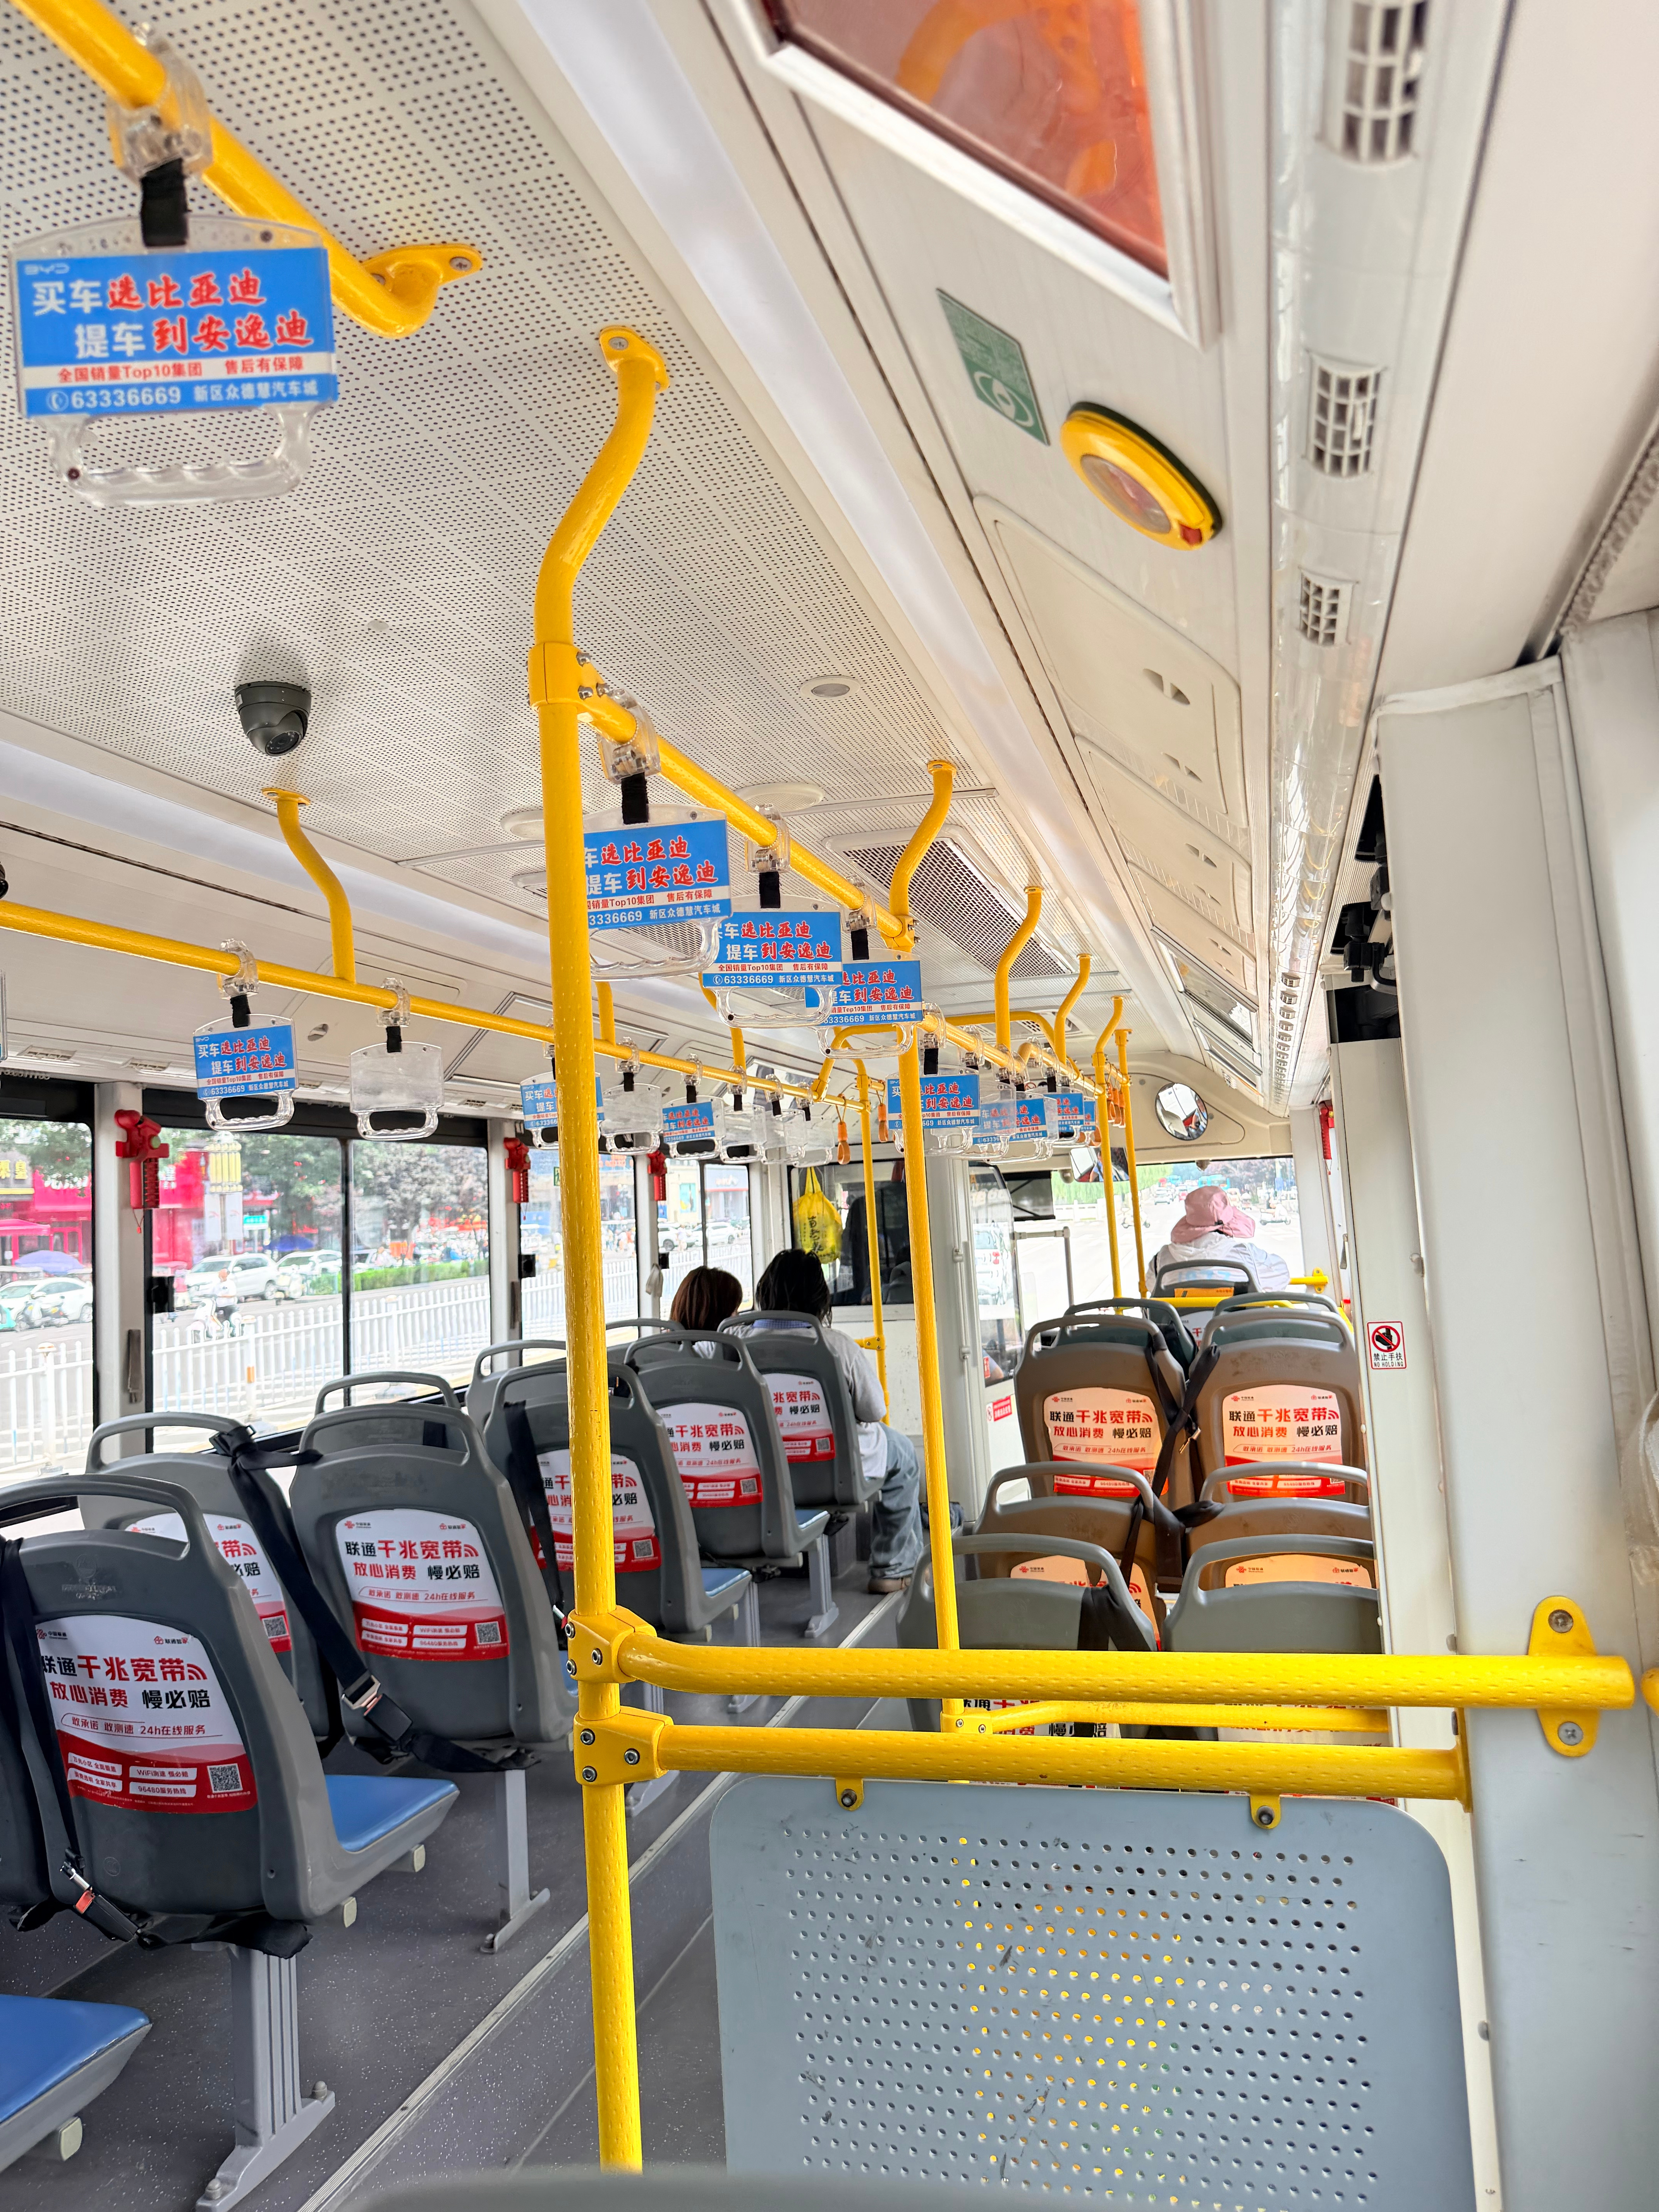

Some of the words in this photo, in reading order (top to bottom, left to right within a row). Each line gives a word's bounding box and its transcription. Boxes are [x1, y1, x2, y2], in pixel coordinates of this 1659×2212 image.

[24, 263, 70, 275] BYD
[33, 267, 267, 316] 买车选比亚迪
[75, 309, 314, 359] 提车到安逸迪
[58, 362, 203, 383] 全国销量Top10集团
[225, 356, 304, 375] 售后有保障
[71, 386, 181, 409] 63336669
[585, 835, 691, 868] 车选比亚迪
[667, 889, 713, 903] 售后有保障
[589, 910, 642, 926] 3336669
[649, 903, 721, 919] 新区众德慧汽车城
[726, 941, 832, 960] 提车到安逸迪
[724, 975, 773, 984] 63336669
[779, 975, 834, 983] 新区众德慧汽车城
[198, 1035, 271, 1058] 买车选比亚迪
[211, 1051, 287, 1075] 提车到安逸迪
[211, 1085, 245, 1095] 63336669
[1374, 1352, 1403, 1361] 禁止手扶
[1050, 1410, 1141, 1424] 联通千兆宽带
[1229, 1407, 1327, 1422] 联通千兆宽带
[667, 1423, 733, 1437] 通千兆宽带
[1053, 1425, 1104, 1438] 放心消费
[1112, 1427, 1151, 1439] 慢必赔
[1233, 1426, 1287, 1437] 放心消费
[1297, 1424, 1338, 1437] 慢必赔
[709, 1439, 744, 1451] 慢必赔
[345, 1540, 462, 1559] 联通千兆宽带
[353, 1561, 417, 1580] 放心消费
[428, 1564, 480, 1580] 慢必赔
[424, 1591, 475, 1601] 24h在线服务
[50, 1681, 129, 1708] 放心消费
[142, 1689, 211, 1709] 慢必赔
[72, 1717, 99, 1730] 敢承诺
[104, 1723, 134, 1735] 敢测速
[140, 1724, 206, 1736] 24h在线服务
